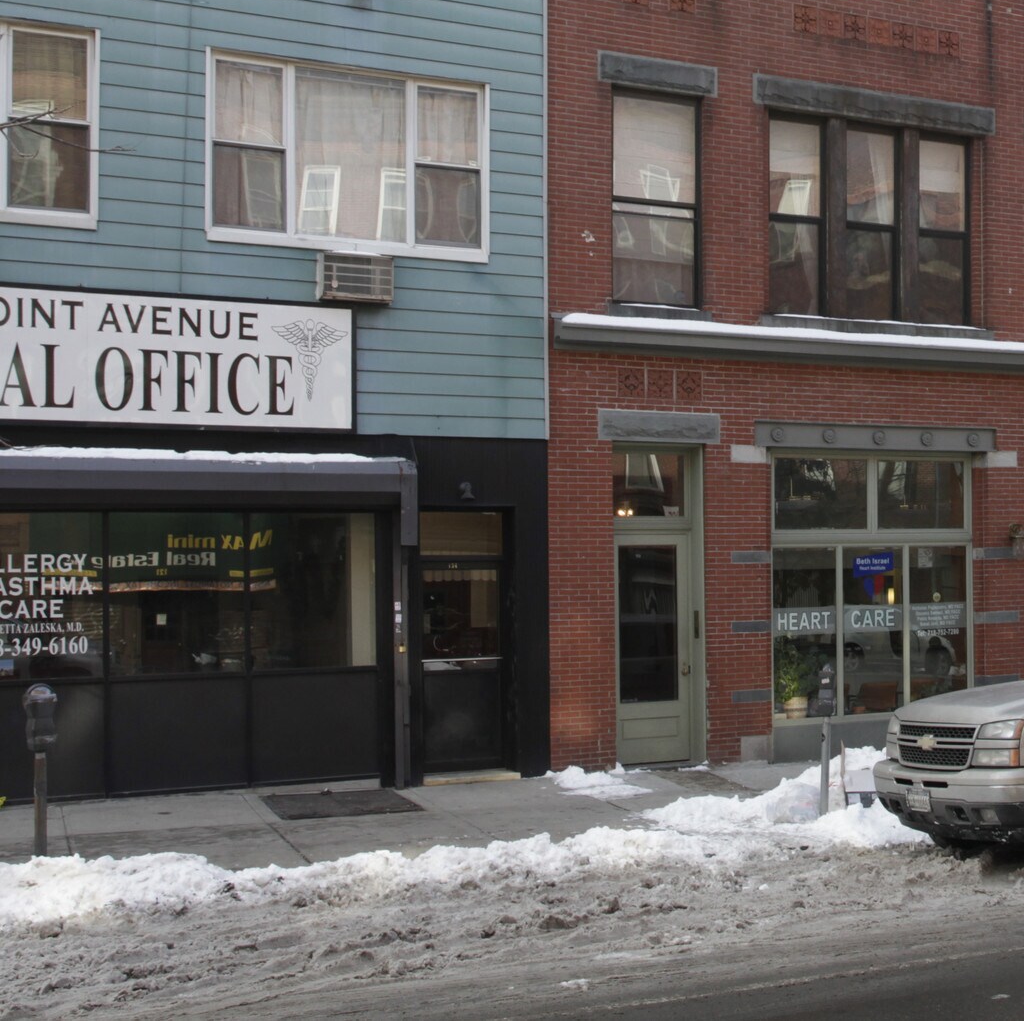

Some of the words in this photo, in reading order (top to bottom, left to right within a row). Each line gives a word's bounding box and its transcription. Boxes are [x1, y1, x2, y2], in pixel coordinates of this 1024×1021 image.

[97, 303, 259, 342] AVENUE
[0, 341, 75, 409] AL
[95, 346, 295, 416] OFFICE
[856, 557, 871, 565] Beth
[872, 557, 890, 565] Israel
[0, 599, 64, 619] CARE
[23, 623, 65, 634] ZALESKA,
[66, 622, 85, 633] M.D.
[777, 611, 831, 631] HEART
[851, 609, 896, 628] CARE
